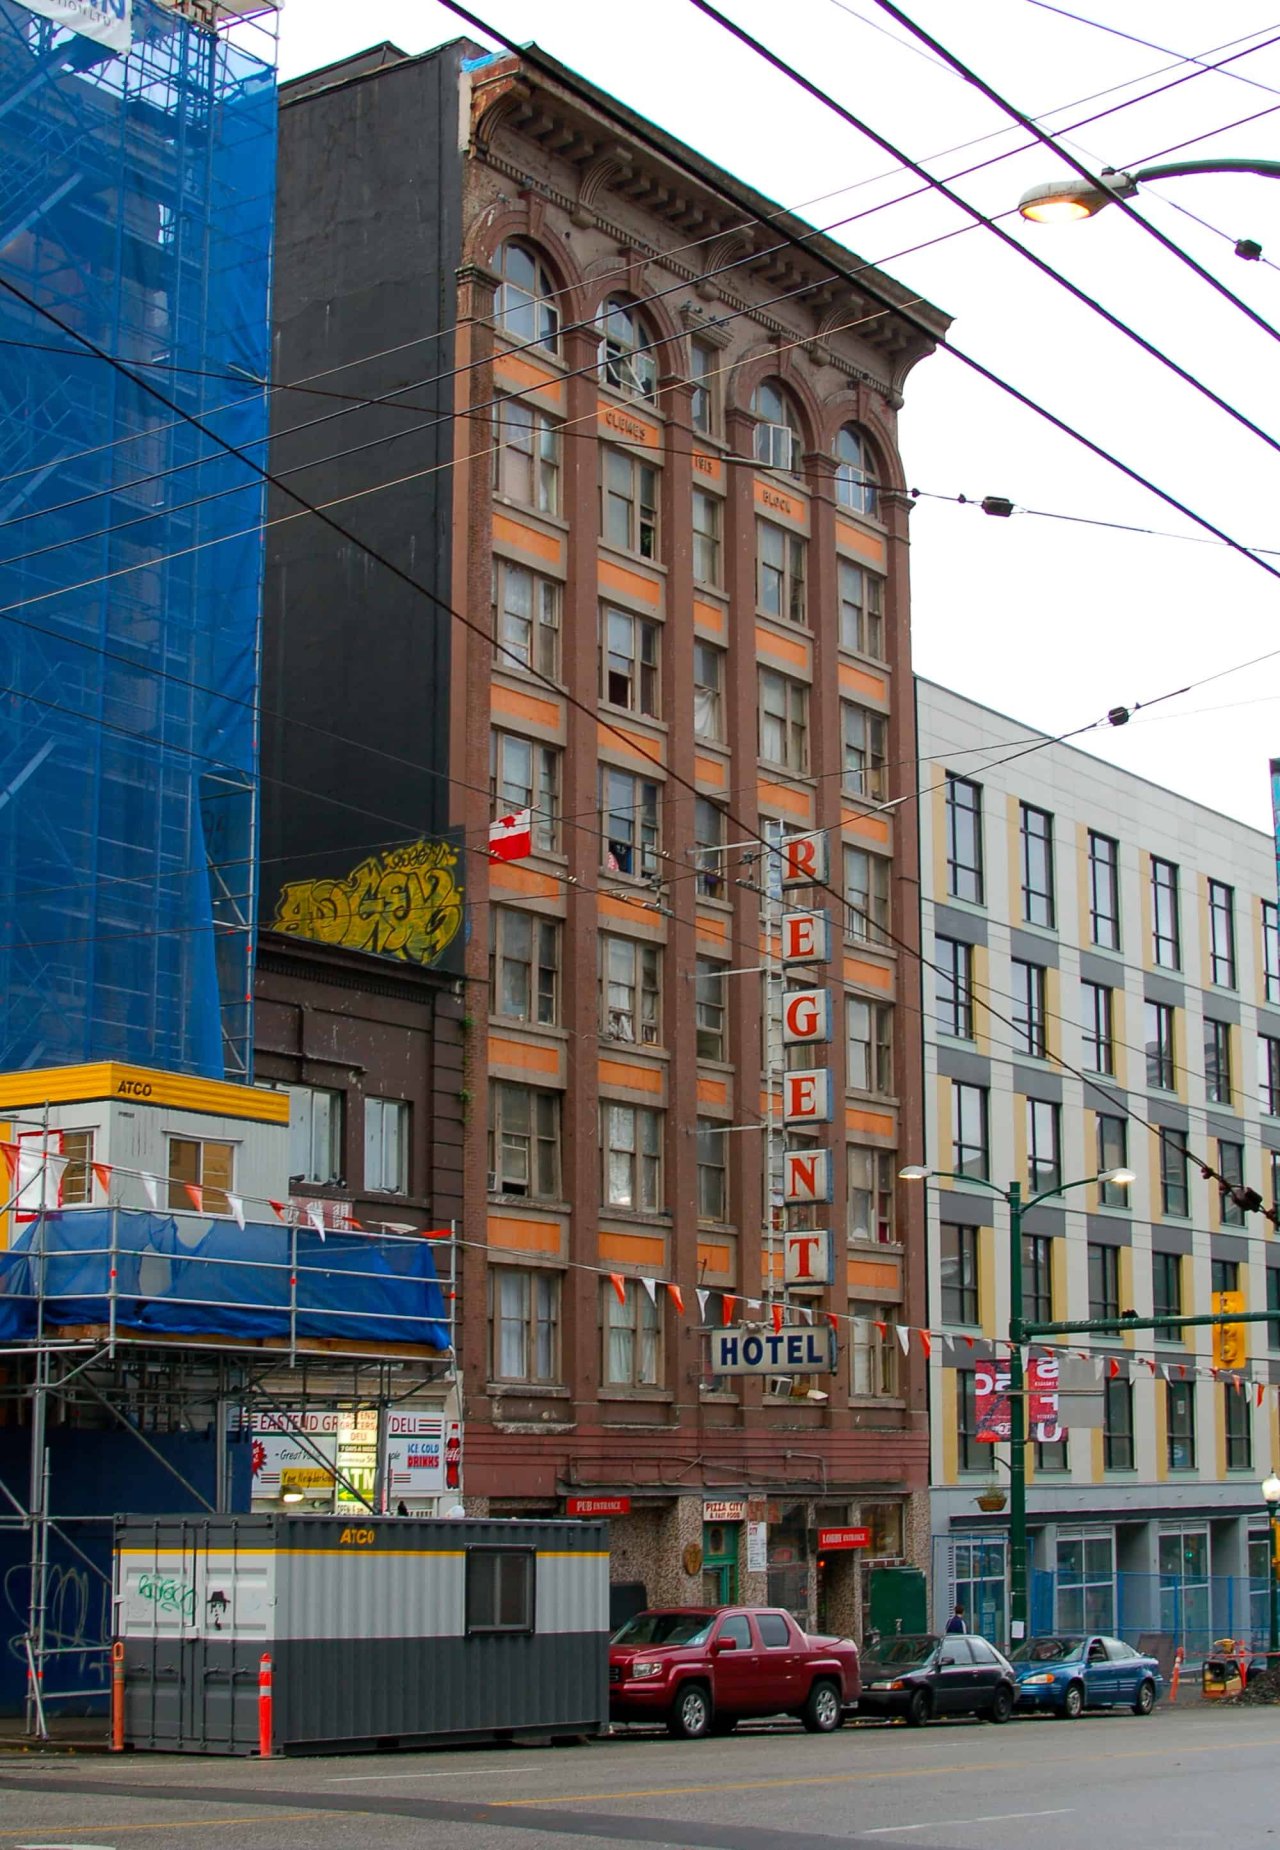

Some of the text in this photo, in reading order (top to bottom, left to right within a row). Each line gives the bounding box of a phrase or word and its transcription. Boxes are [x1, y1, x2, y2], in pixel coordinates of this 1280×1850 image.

[785, 839, 819, 1279] REGENT
[118, 1080, 152, 1097] ATCO
[721, 1335, 823, 1366] HOTEL
[280, 1449, 302, 1460] Great
[407, 1443, 439, 1453] ICE COLD
[407, 1455, 439, 1468] DRINKS
[576, 1500, 593, 1512] PUB
[705, 1502, 744, 1512] PIZZA CITY
[340, 1528, 375, 1545] ATCO
